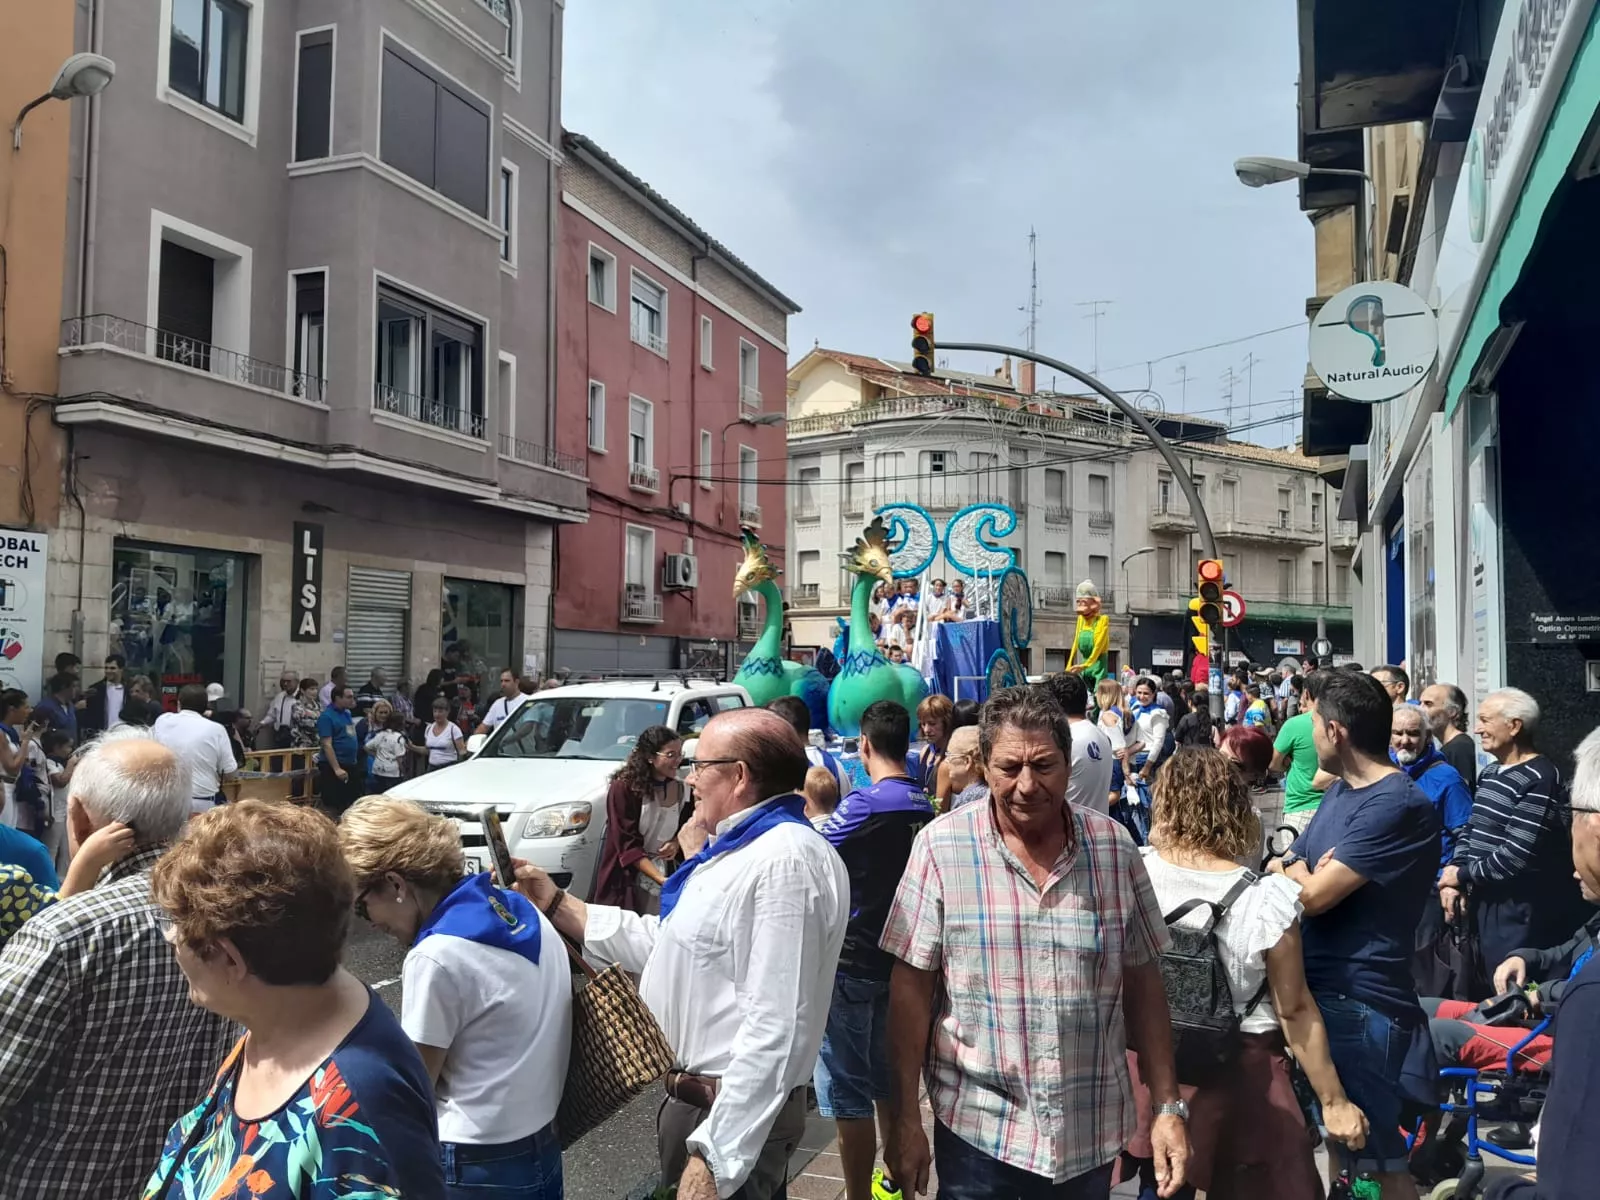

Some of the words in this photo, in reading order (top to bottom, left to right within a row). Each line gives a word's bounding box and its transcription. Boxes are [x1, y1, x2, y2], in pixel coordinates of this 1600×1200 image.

[1327, 368, 1379, 383] Natural
[1382, 364, 1424, 377] Audio
[299, 530, 318, 635] LISA
